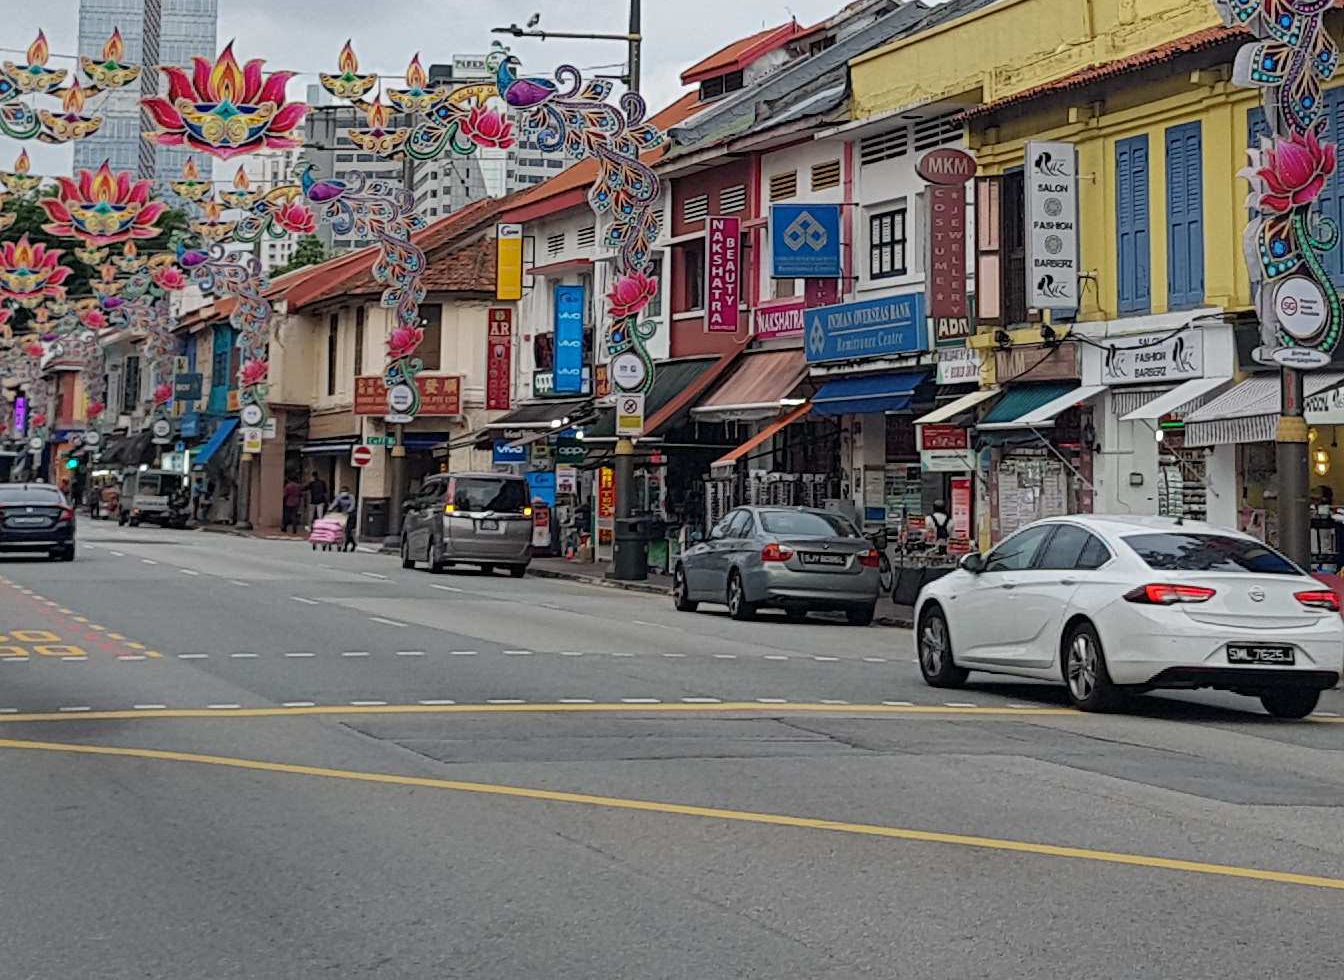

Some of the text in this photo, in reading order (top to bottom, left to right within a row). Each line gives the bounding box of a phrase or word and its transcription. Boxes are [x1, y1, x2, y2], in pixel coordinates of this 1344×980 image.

[928, 157, 969, 175] MKM
[1037, 184, 1068, 193] SALON
[933, 189, 948, 286] COSTUME
[1033, 221, 1073, 231] FASHION
[711, 219, 725, 324] NAKSHATRA
[725, 237, 736, 307] BEAUTY
[949, 207, 964, 315] JEWELLERY
[1134, 352, 1166, 363] FASHION
